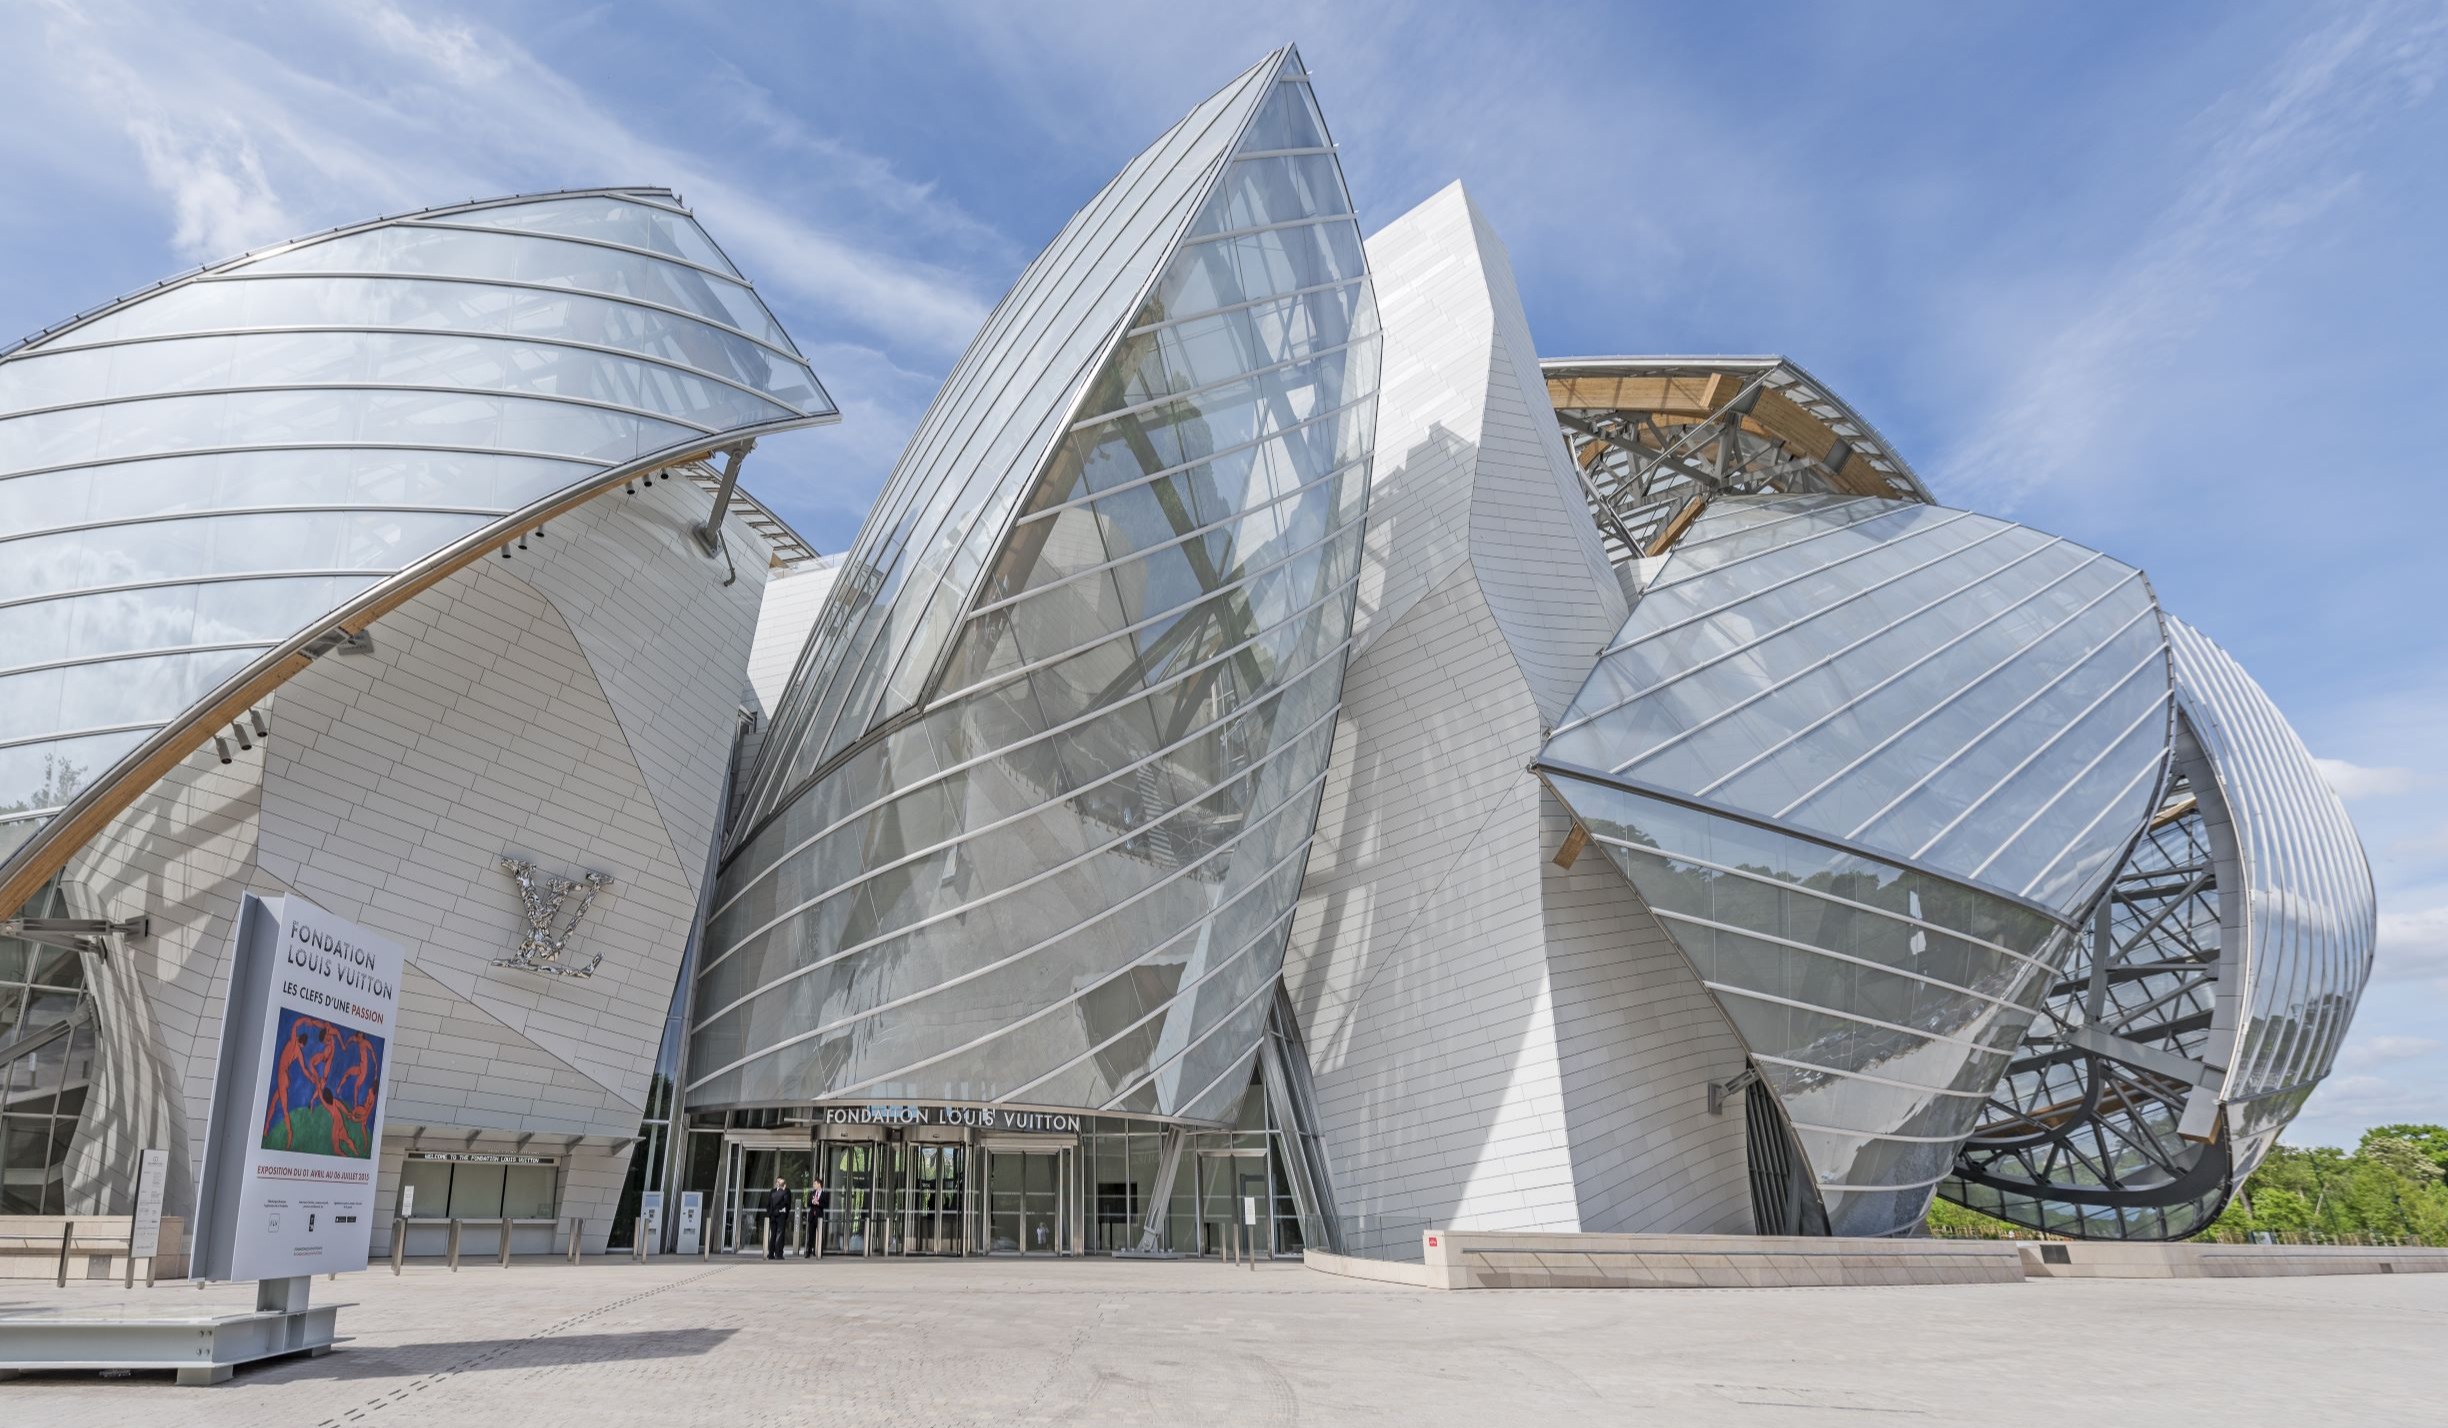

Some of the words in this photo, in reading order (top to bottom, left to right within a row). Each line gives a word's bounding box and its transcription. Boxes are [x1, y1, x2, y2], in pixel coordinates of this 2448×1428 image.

[291, 921, 376, 971] FONDATION
[287, 944, 332, 977] LOUIS
[337, 963, 393, 1001] VUITTON
[282, 980, 298, 996] LES
[299, 986, 324, 1005] CLEFS
[324, 994, 350, 1014] D'UNE
[351, 1004, 384, 1025] PASSION
[826, 1108, 929, 1125] FONDATION
[939, 1108, 995, 1127] LOUIS
[1005, 1111, 1082, 1132] VUITTON
[257, 1165, 293, 1177] EXPOSITION
[293, 1168, 302, 1177] DU
[303, 1168, 309, 1177] 01
[310, 1169, 325, 1179] AVRIL
[325, 1171, 334, 1179] AU
[334, 1171, 341, 1180] 06
[341, 1172, 358, 1181] JUILLET
[358, 1173, 370, 1182] 2015
[500, 1156, 516, 1164] LOUIS
